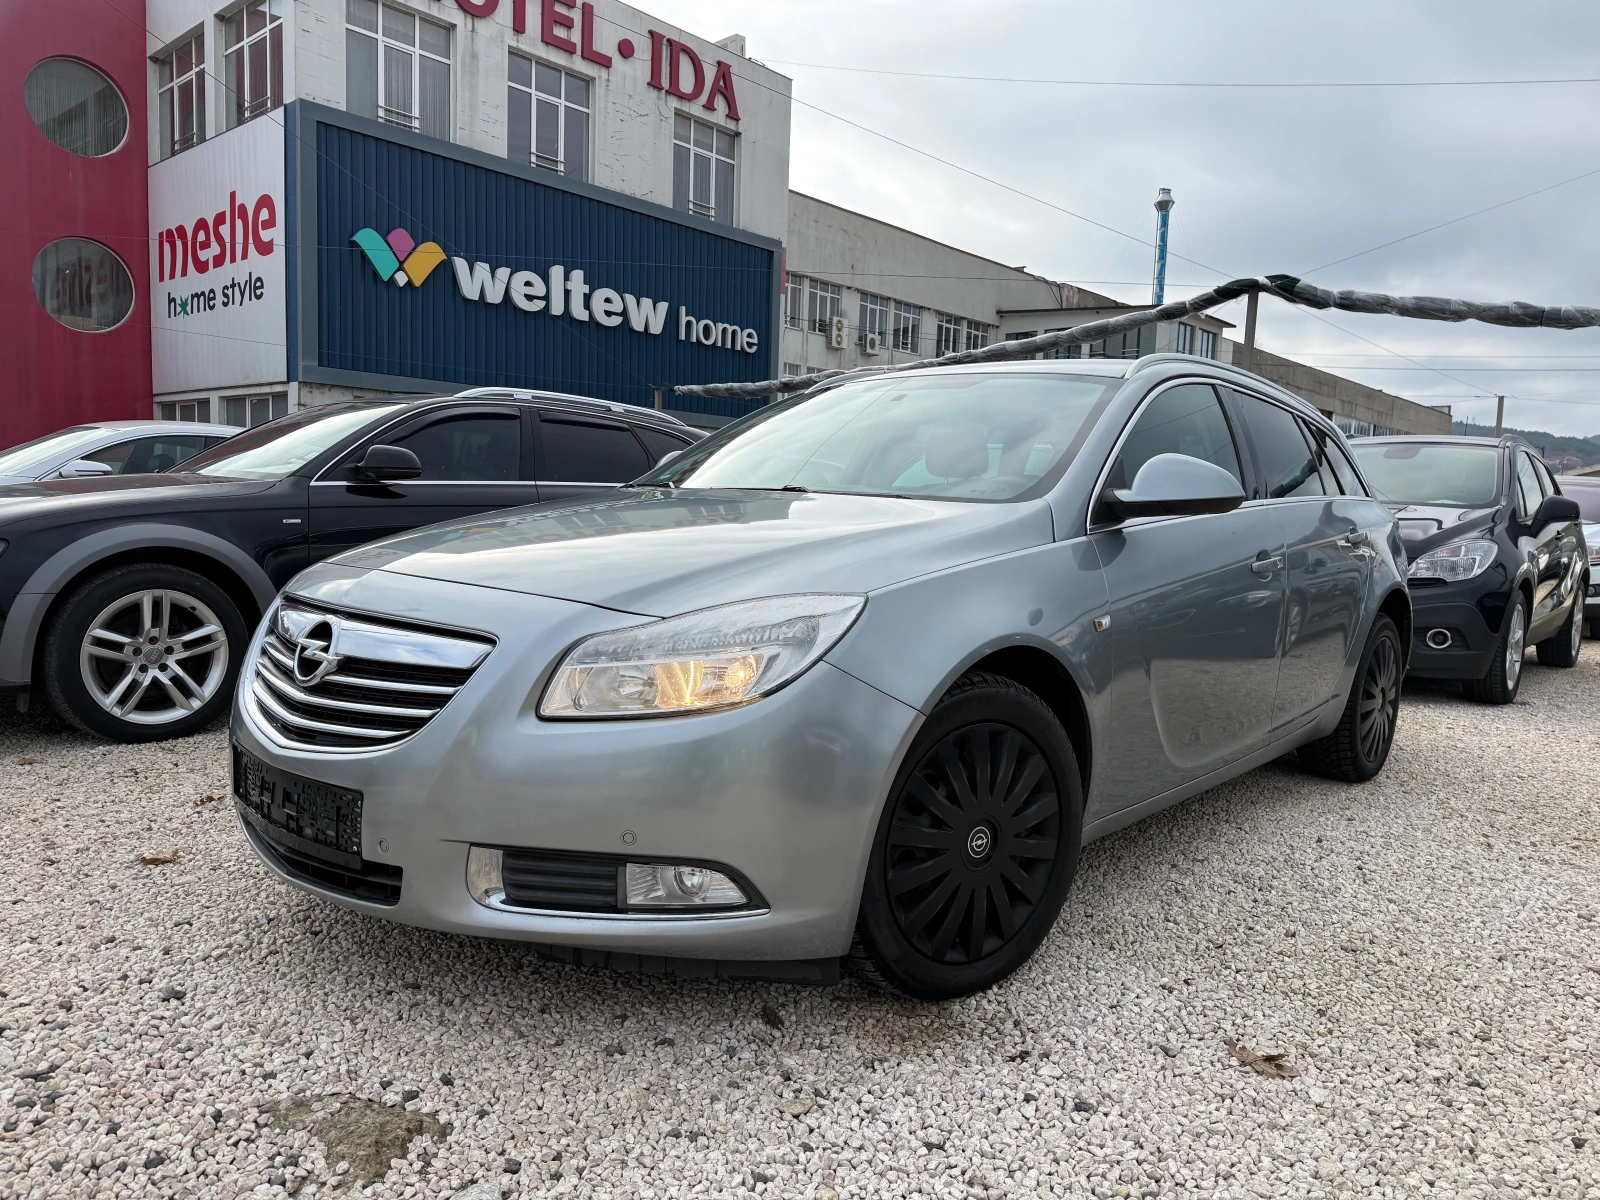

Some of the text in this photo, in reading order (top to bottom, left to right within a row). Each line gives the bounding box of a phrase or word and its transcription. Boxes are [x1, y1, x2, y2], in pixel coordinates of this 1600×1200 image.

[455, 0, 741, 121] EL IDA
[158, 190, 276, 283] meshe
[221, 271, 265, 307] style
[451, 256, 758, 354] weltew home
